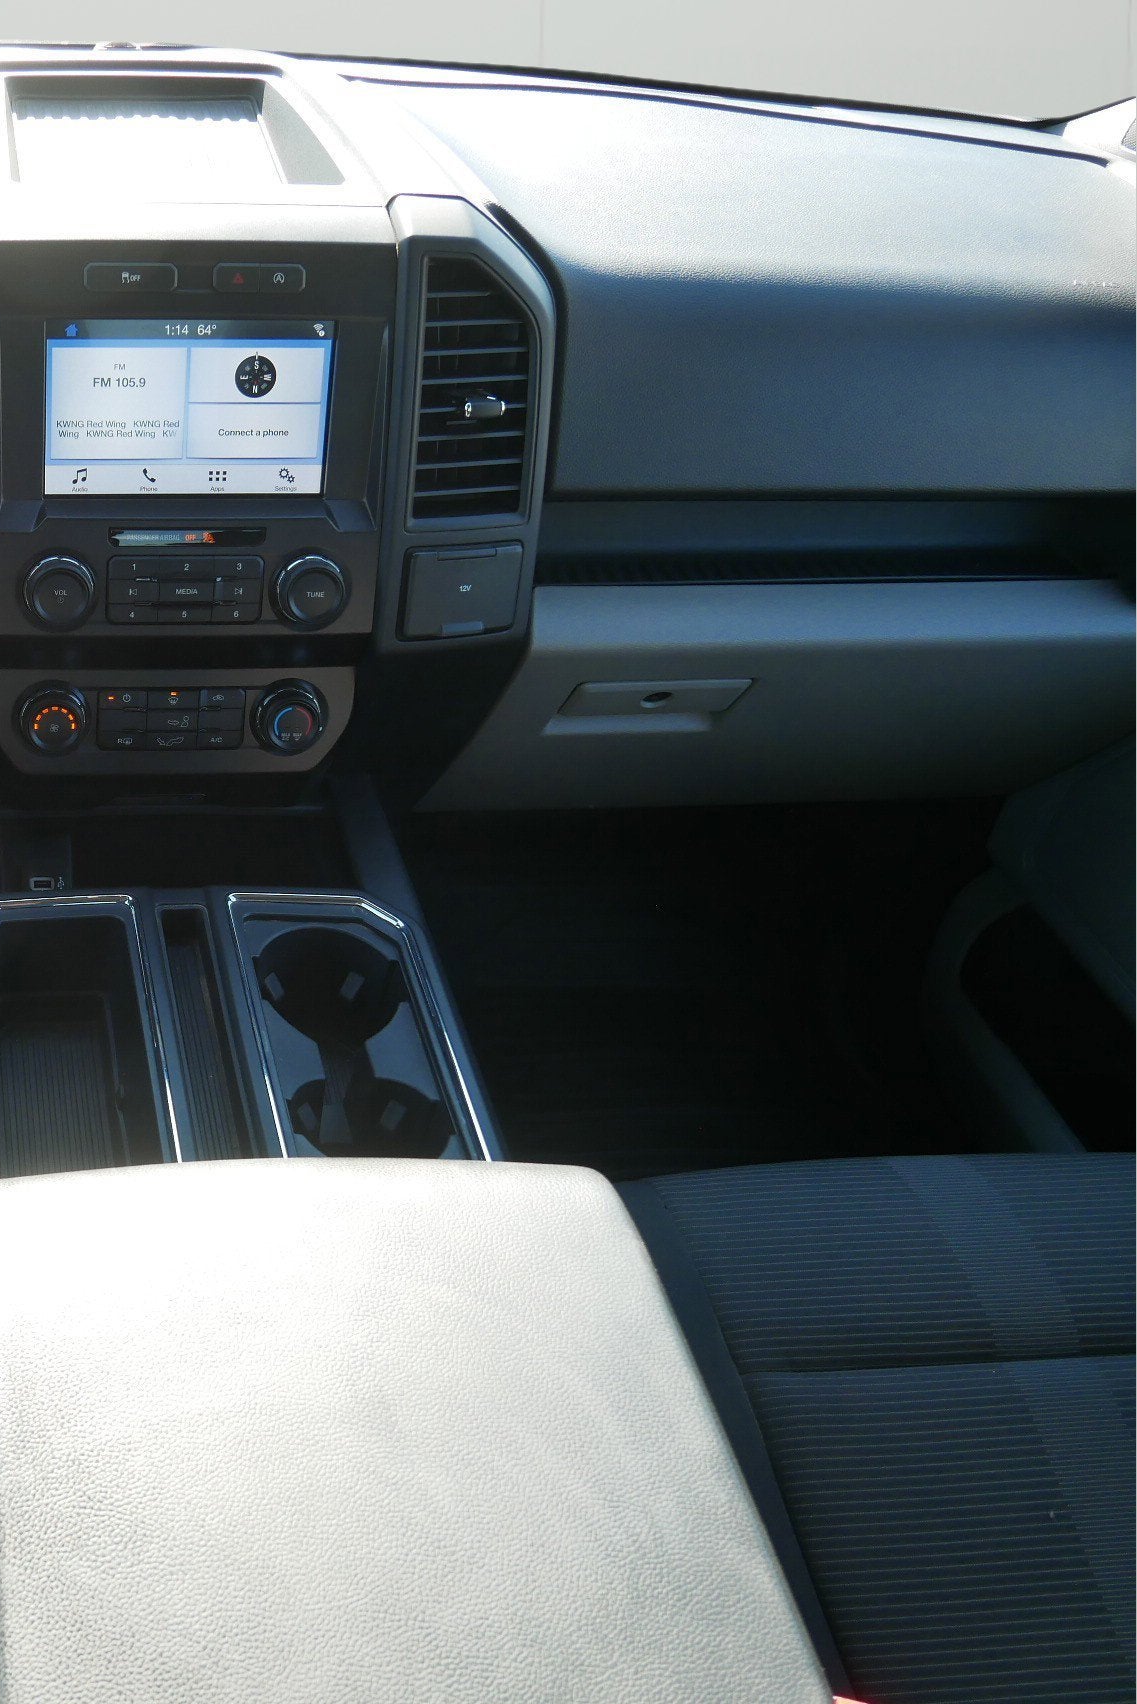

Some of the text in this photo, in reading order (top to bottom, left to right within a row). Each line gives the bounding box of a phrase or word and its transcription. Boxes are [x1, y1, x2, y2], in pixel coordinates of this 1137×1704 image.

[164, 324, 189, 336] 1:14
[113, 363, 126, 371] FM
[254, 360, 260, 370] S
[92, 377, 146, 388] FM 105.9
[252, 385, 258, 394] N
[56, 419, 180, 429] KWNG Red Wing KWNG Red
[58, 430, 80, 439] Wing
[86, 430, 114, 438] KWNG
[116, 430, 133, 438] Red
[134, 430, 156, 439] Wing
[218, 428, 254, 437] Connect
[262, 428, 289, 438] phone
[274, 485, 298, 494] Settings
[184, 563, 190, 571] 2
[236, 562, 242, 570] 3
[459, 584, 472, 592] 12V
[233, 610, 239, 618] 6
